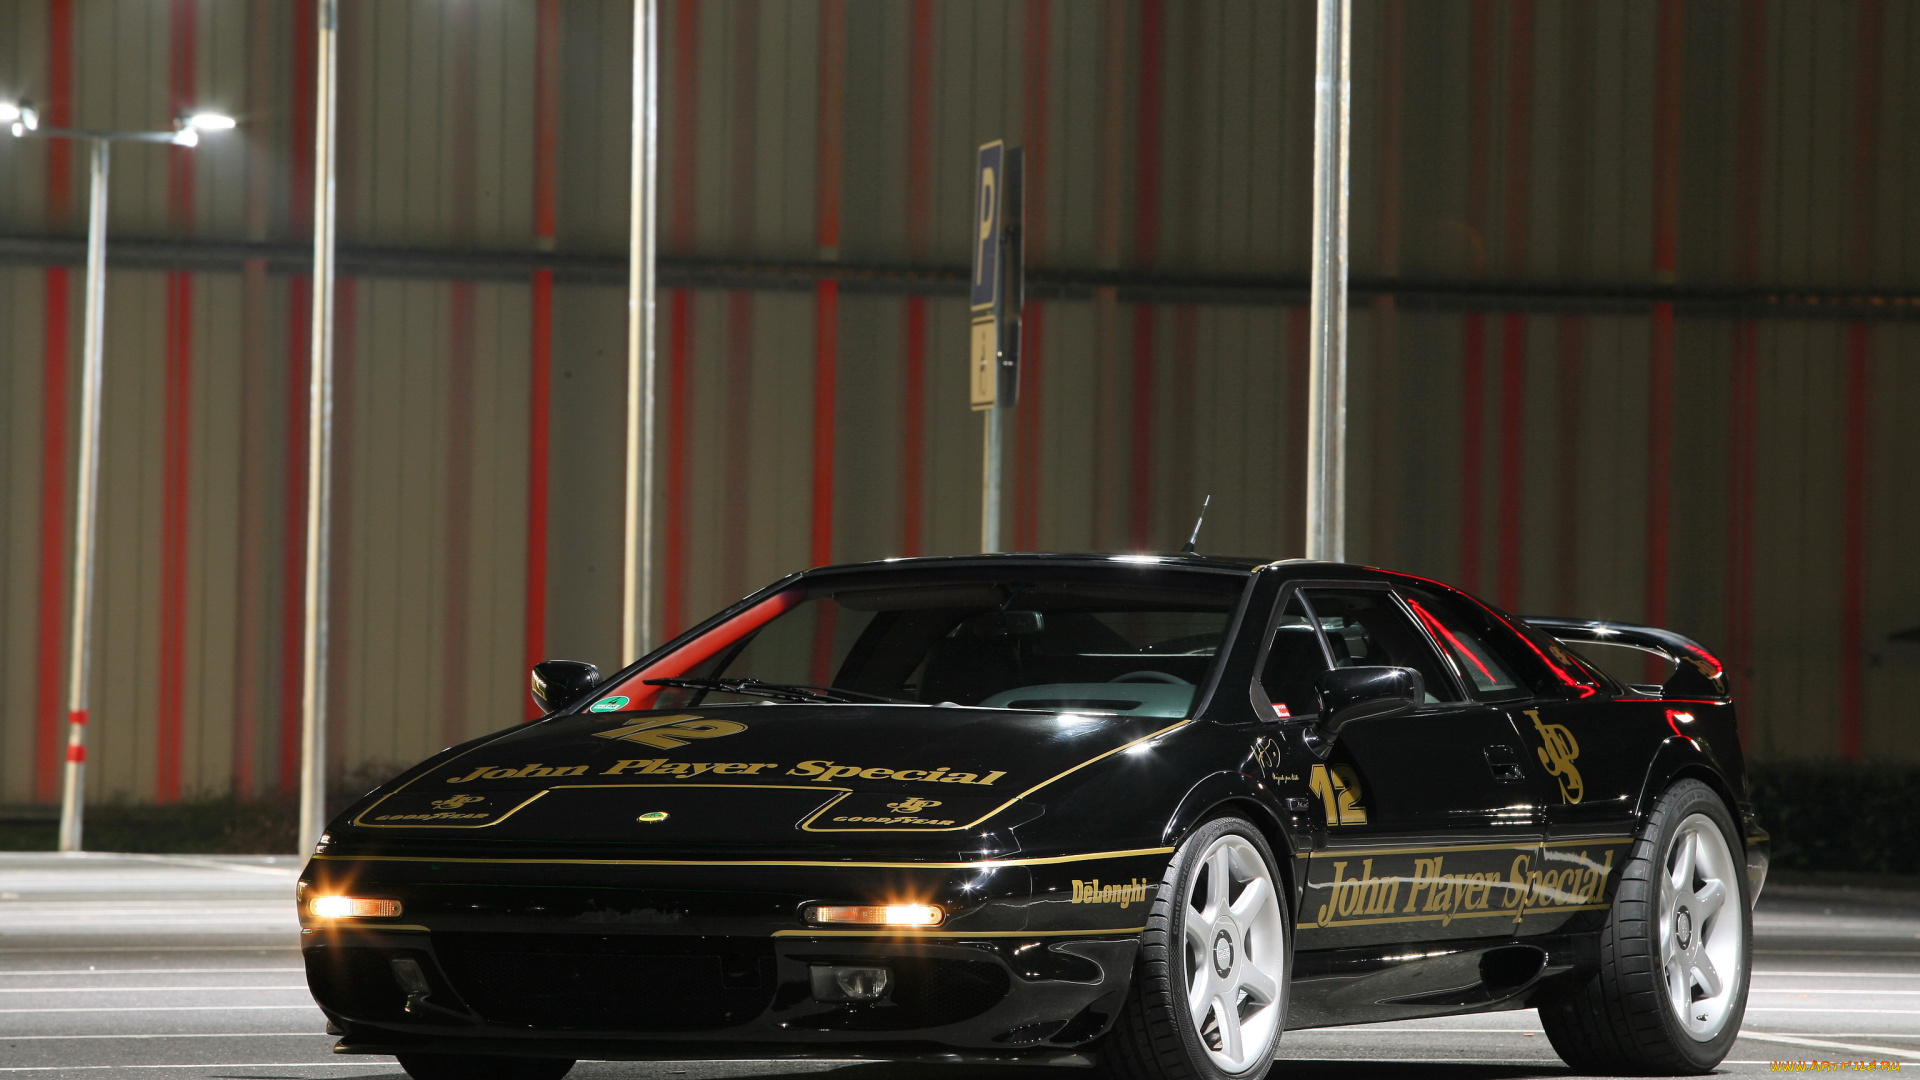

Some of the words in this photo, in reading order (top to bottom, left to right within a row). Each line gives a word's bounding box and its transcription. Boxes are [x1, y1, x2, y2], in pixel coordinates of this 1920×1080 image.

[976, 167, 996, 286] P
[591, 714, 749, 750] 12
[446, 763, 590, 783] John
[599, 758, 779, 779] Player
[786, 760, 1008, 786] Special
[1309, 763, 1368, 826] 12
[833, 816, 955, 826] GOODYEAR
[1317, 859, 1400, 928] John
[1403, 856, 1501, 928] Player
[1502, 850, 1614, 923] Special
